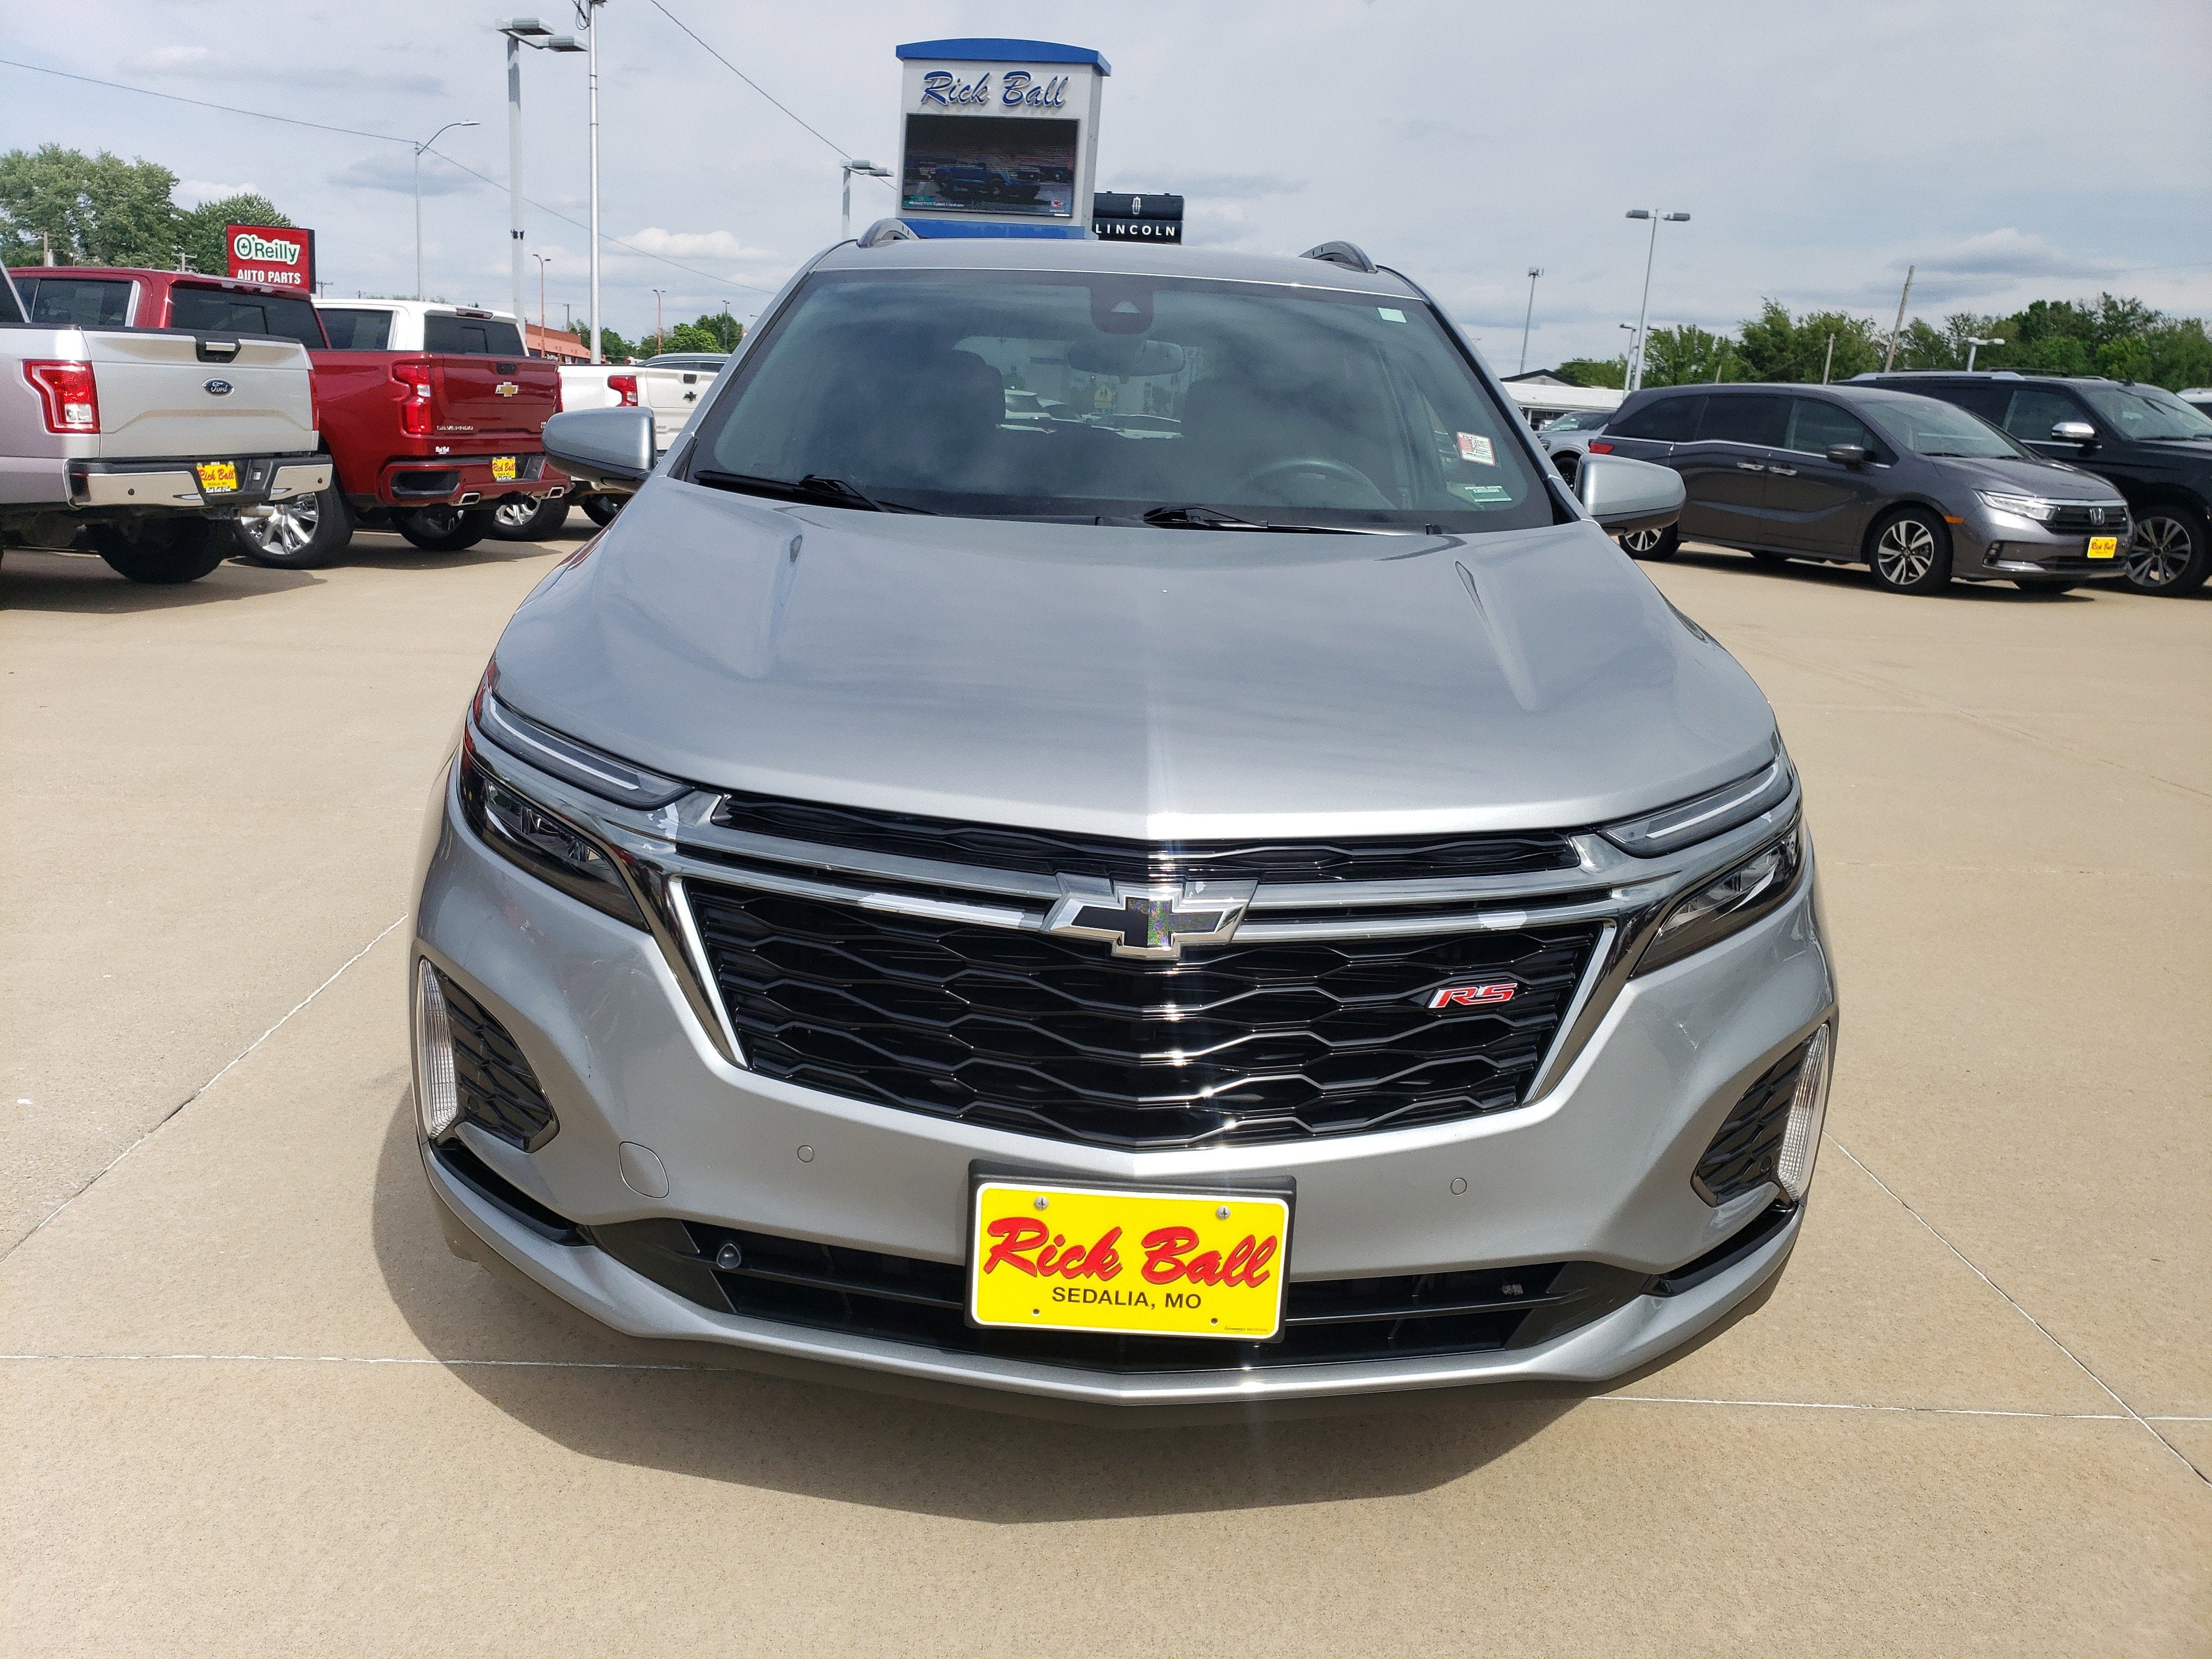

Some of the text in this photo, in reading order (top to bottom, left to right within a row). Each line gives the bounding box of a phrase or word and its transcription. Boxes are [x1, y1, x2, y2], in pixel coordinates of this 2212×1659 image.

[921, 71, 1069, 106] Rick Ball
[1096, 224, 1175, 236] LINCOLN
[236, 236, 298, 263] O'Reilly
[237, 269, 301, 285] AUTO PARTS
[198, 469, 215, 481] Rick
[1429, 983, 1517, 1008] RS
[983, 1216, 1278, 1288] Rick Ball
[1052, 1286, 1201, 1310] SEDALIA, MO
